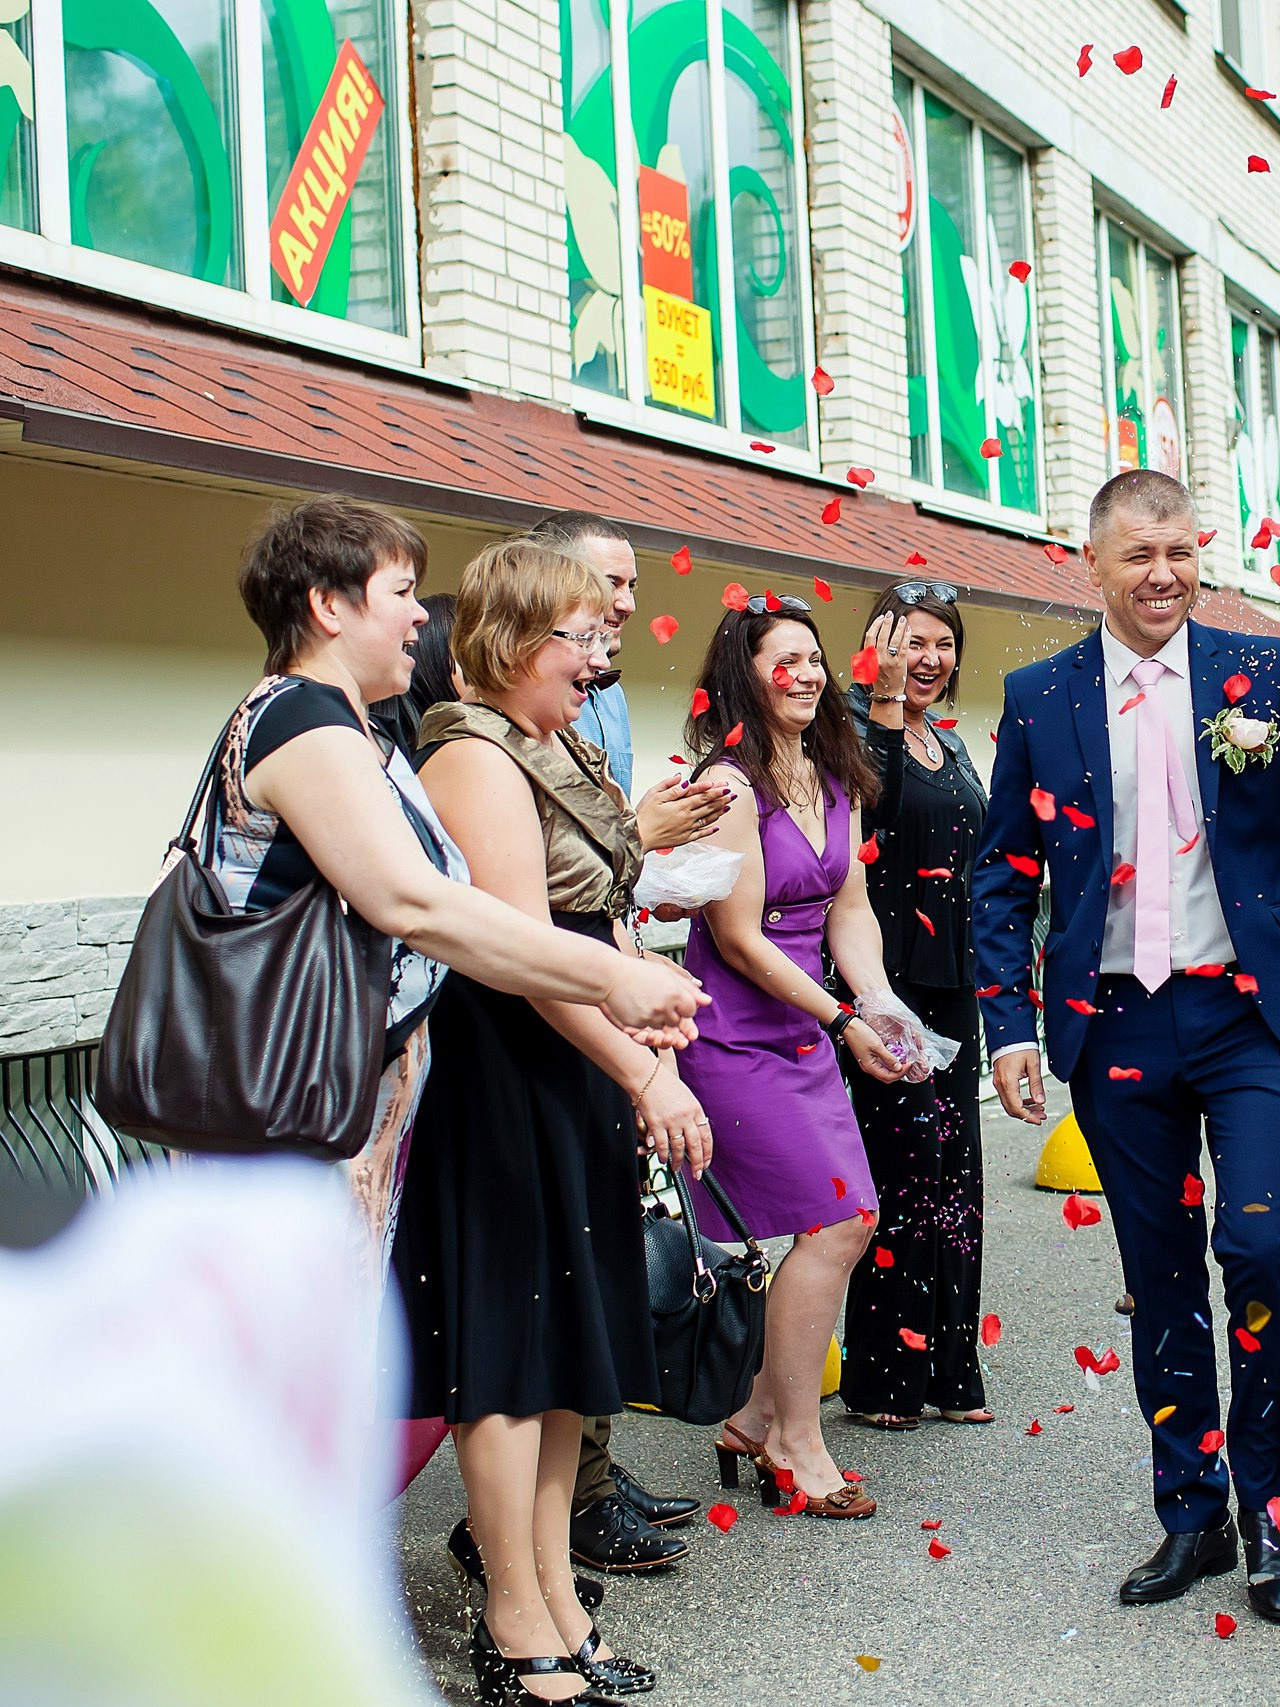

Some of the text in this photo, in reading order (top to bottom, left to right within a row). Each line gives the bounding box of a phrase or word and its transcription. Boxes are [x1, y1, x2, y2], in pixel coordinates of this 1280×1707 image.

[278, 57, 375, 292] АКЦИЯ!
[656, 298, 699, 339] БУКЕТ
[654, 357, 709, 403] 350 руб.
